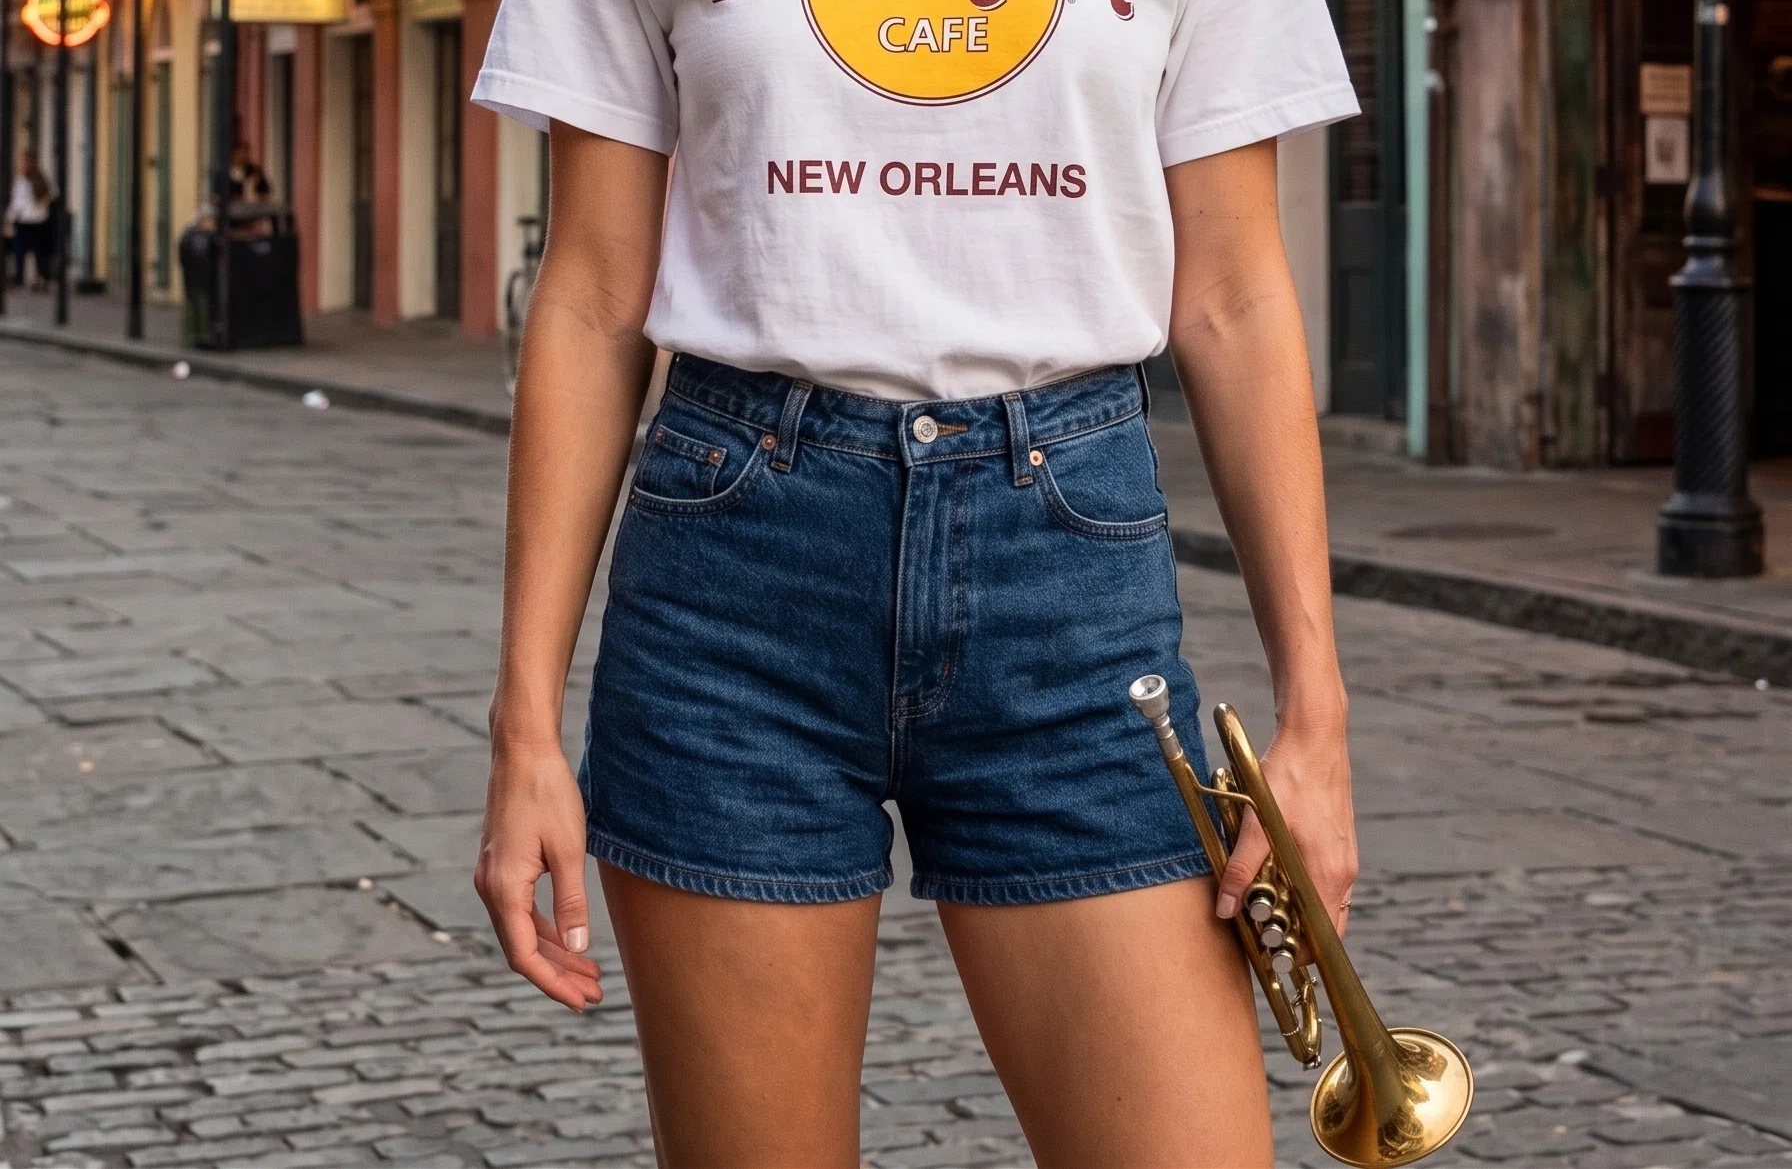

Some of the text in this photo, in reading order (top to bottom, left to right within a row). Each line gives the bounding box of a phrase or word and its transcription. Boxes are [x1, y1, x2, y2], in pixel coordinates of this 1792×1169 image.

[877, 16, 989, 53] CAFE
[767, 160, 1088, 199] NEW ORLEANS
